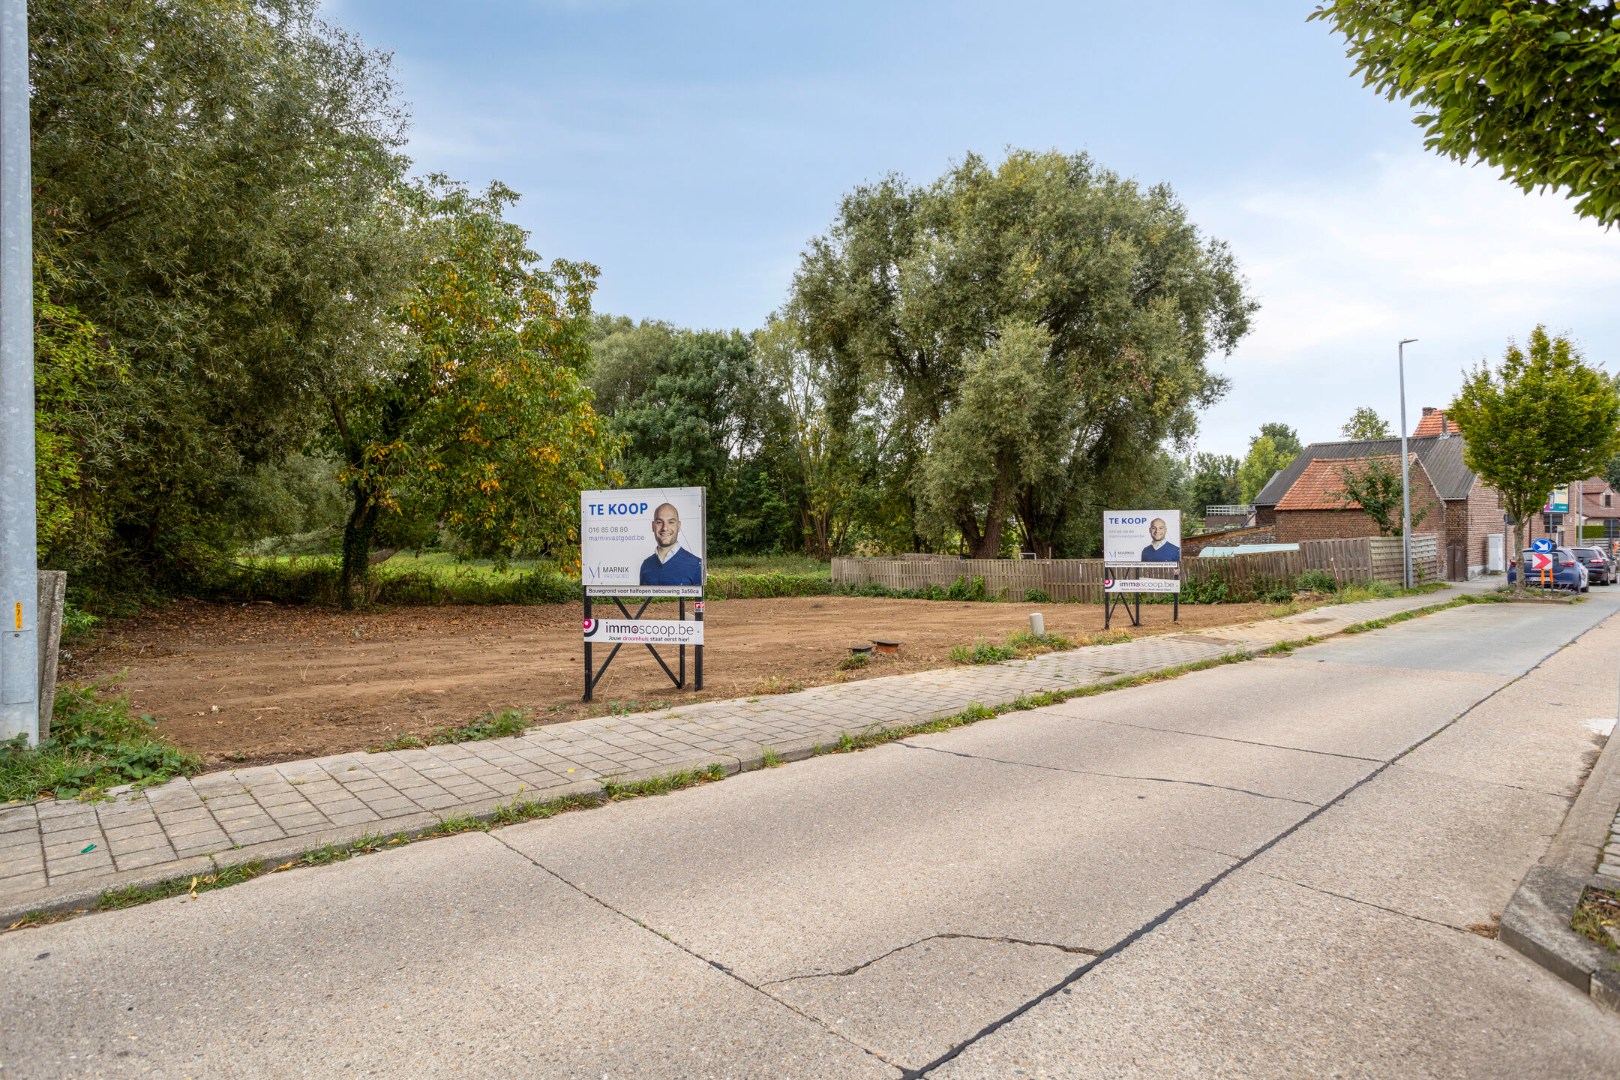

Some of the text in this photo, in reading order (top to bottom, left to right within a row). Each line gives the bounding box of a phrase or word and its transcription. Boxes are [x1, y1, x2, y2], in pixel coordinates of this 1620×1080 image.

[588, 503, 648, 515] TE KOOP
[601, 526, 609, 534] 85
[605, 621, 694, 636] immoscoop.be
